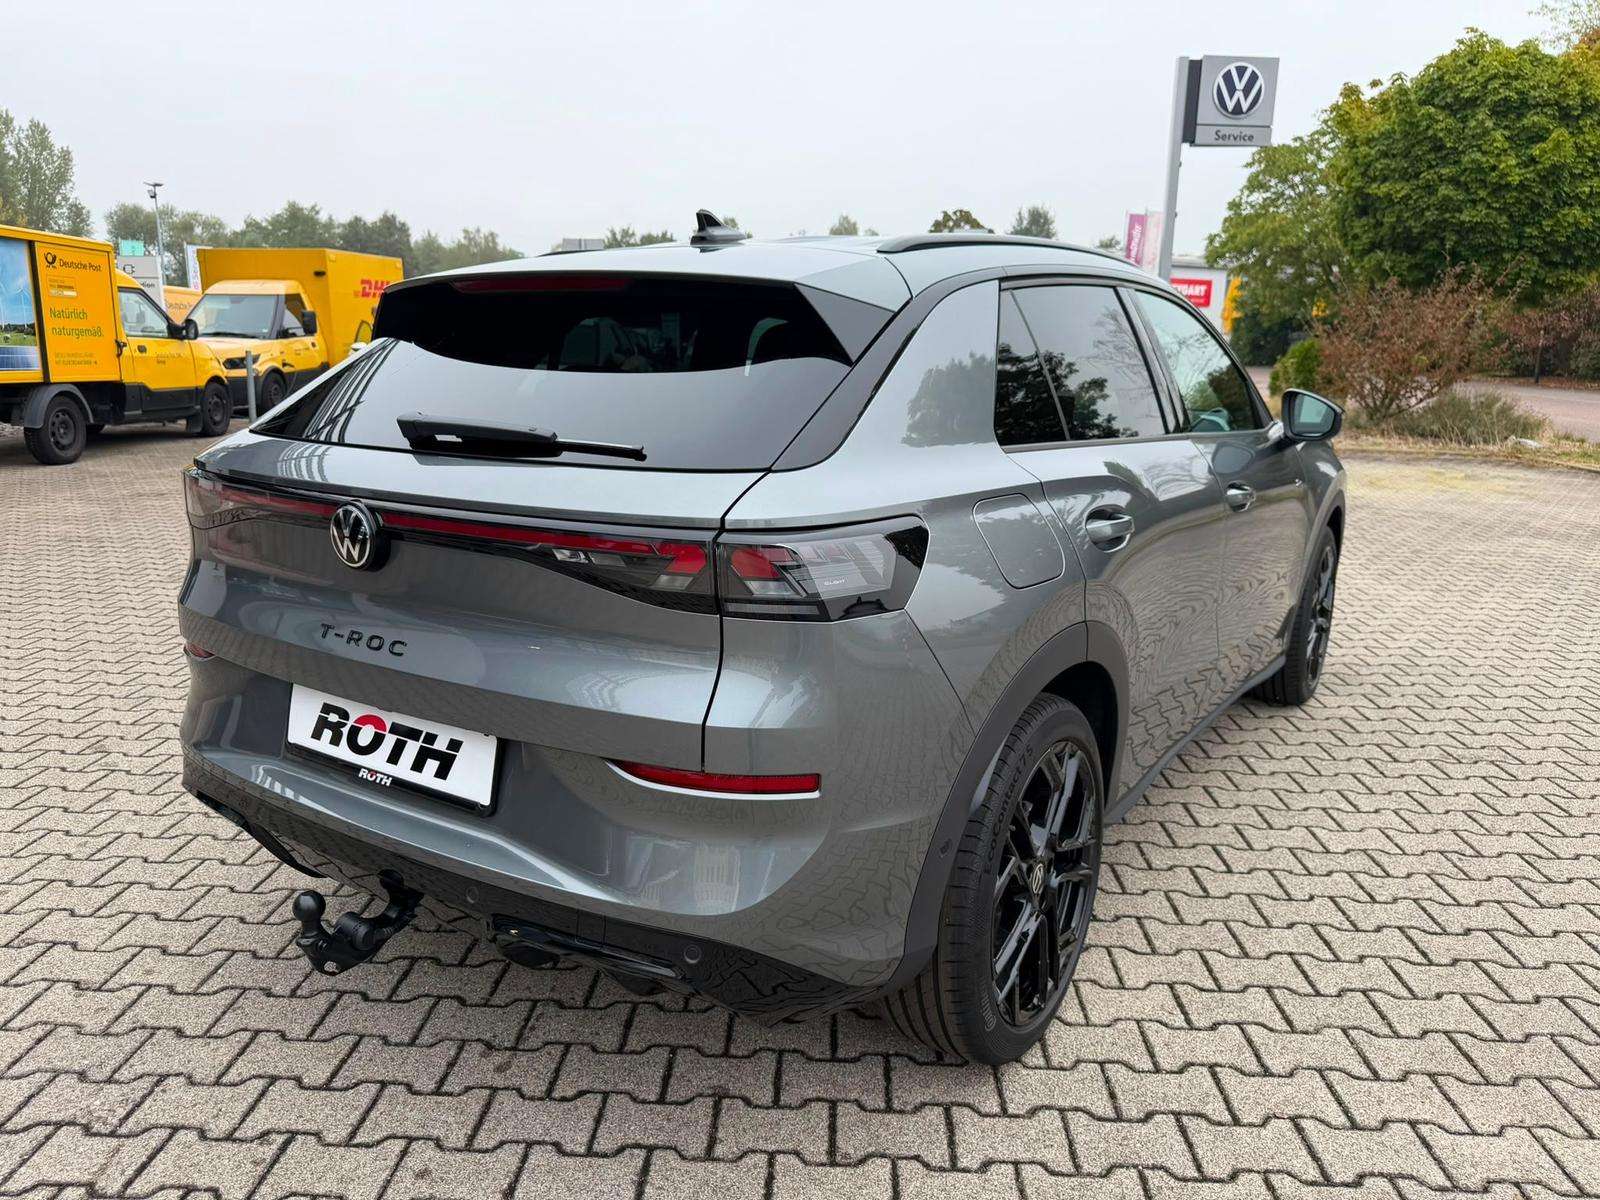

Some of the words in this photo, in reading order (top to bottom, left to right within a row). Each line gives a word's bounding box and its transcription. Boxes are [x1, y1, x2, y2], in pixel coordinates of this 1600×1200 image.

[1214, 130, 1255, 142] Service
[59, 259, 87, 271] Deutsche
[88, 262, 101, 272] Post
[49, 307, 88, 320] Natürlich
[52, 326, 104, 340] naturgemäß.
[320, 622, 408, 657] T-ROC
[310, 702, 465, 781] ROTH
[358, 768, 393, 787] ROTH
